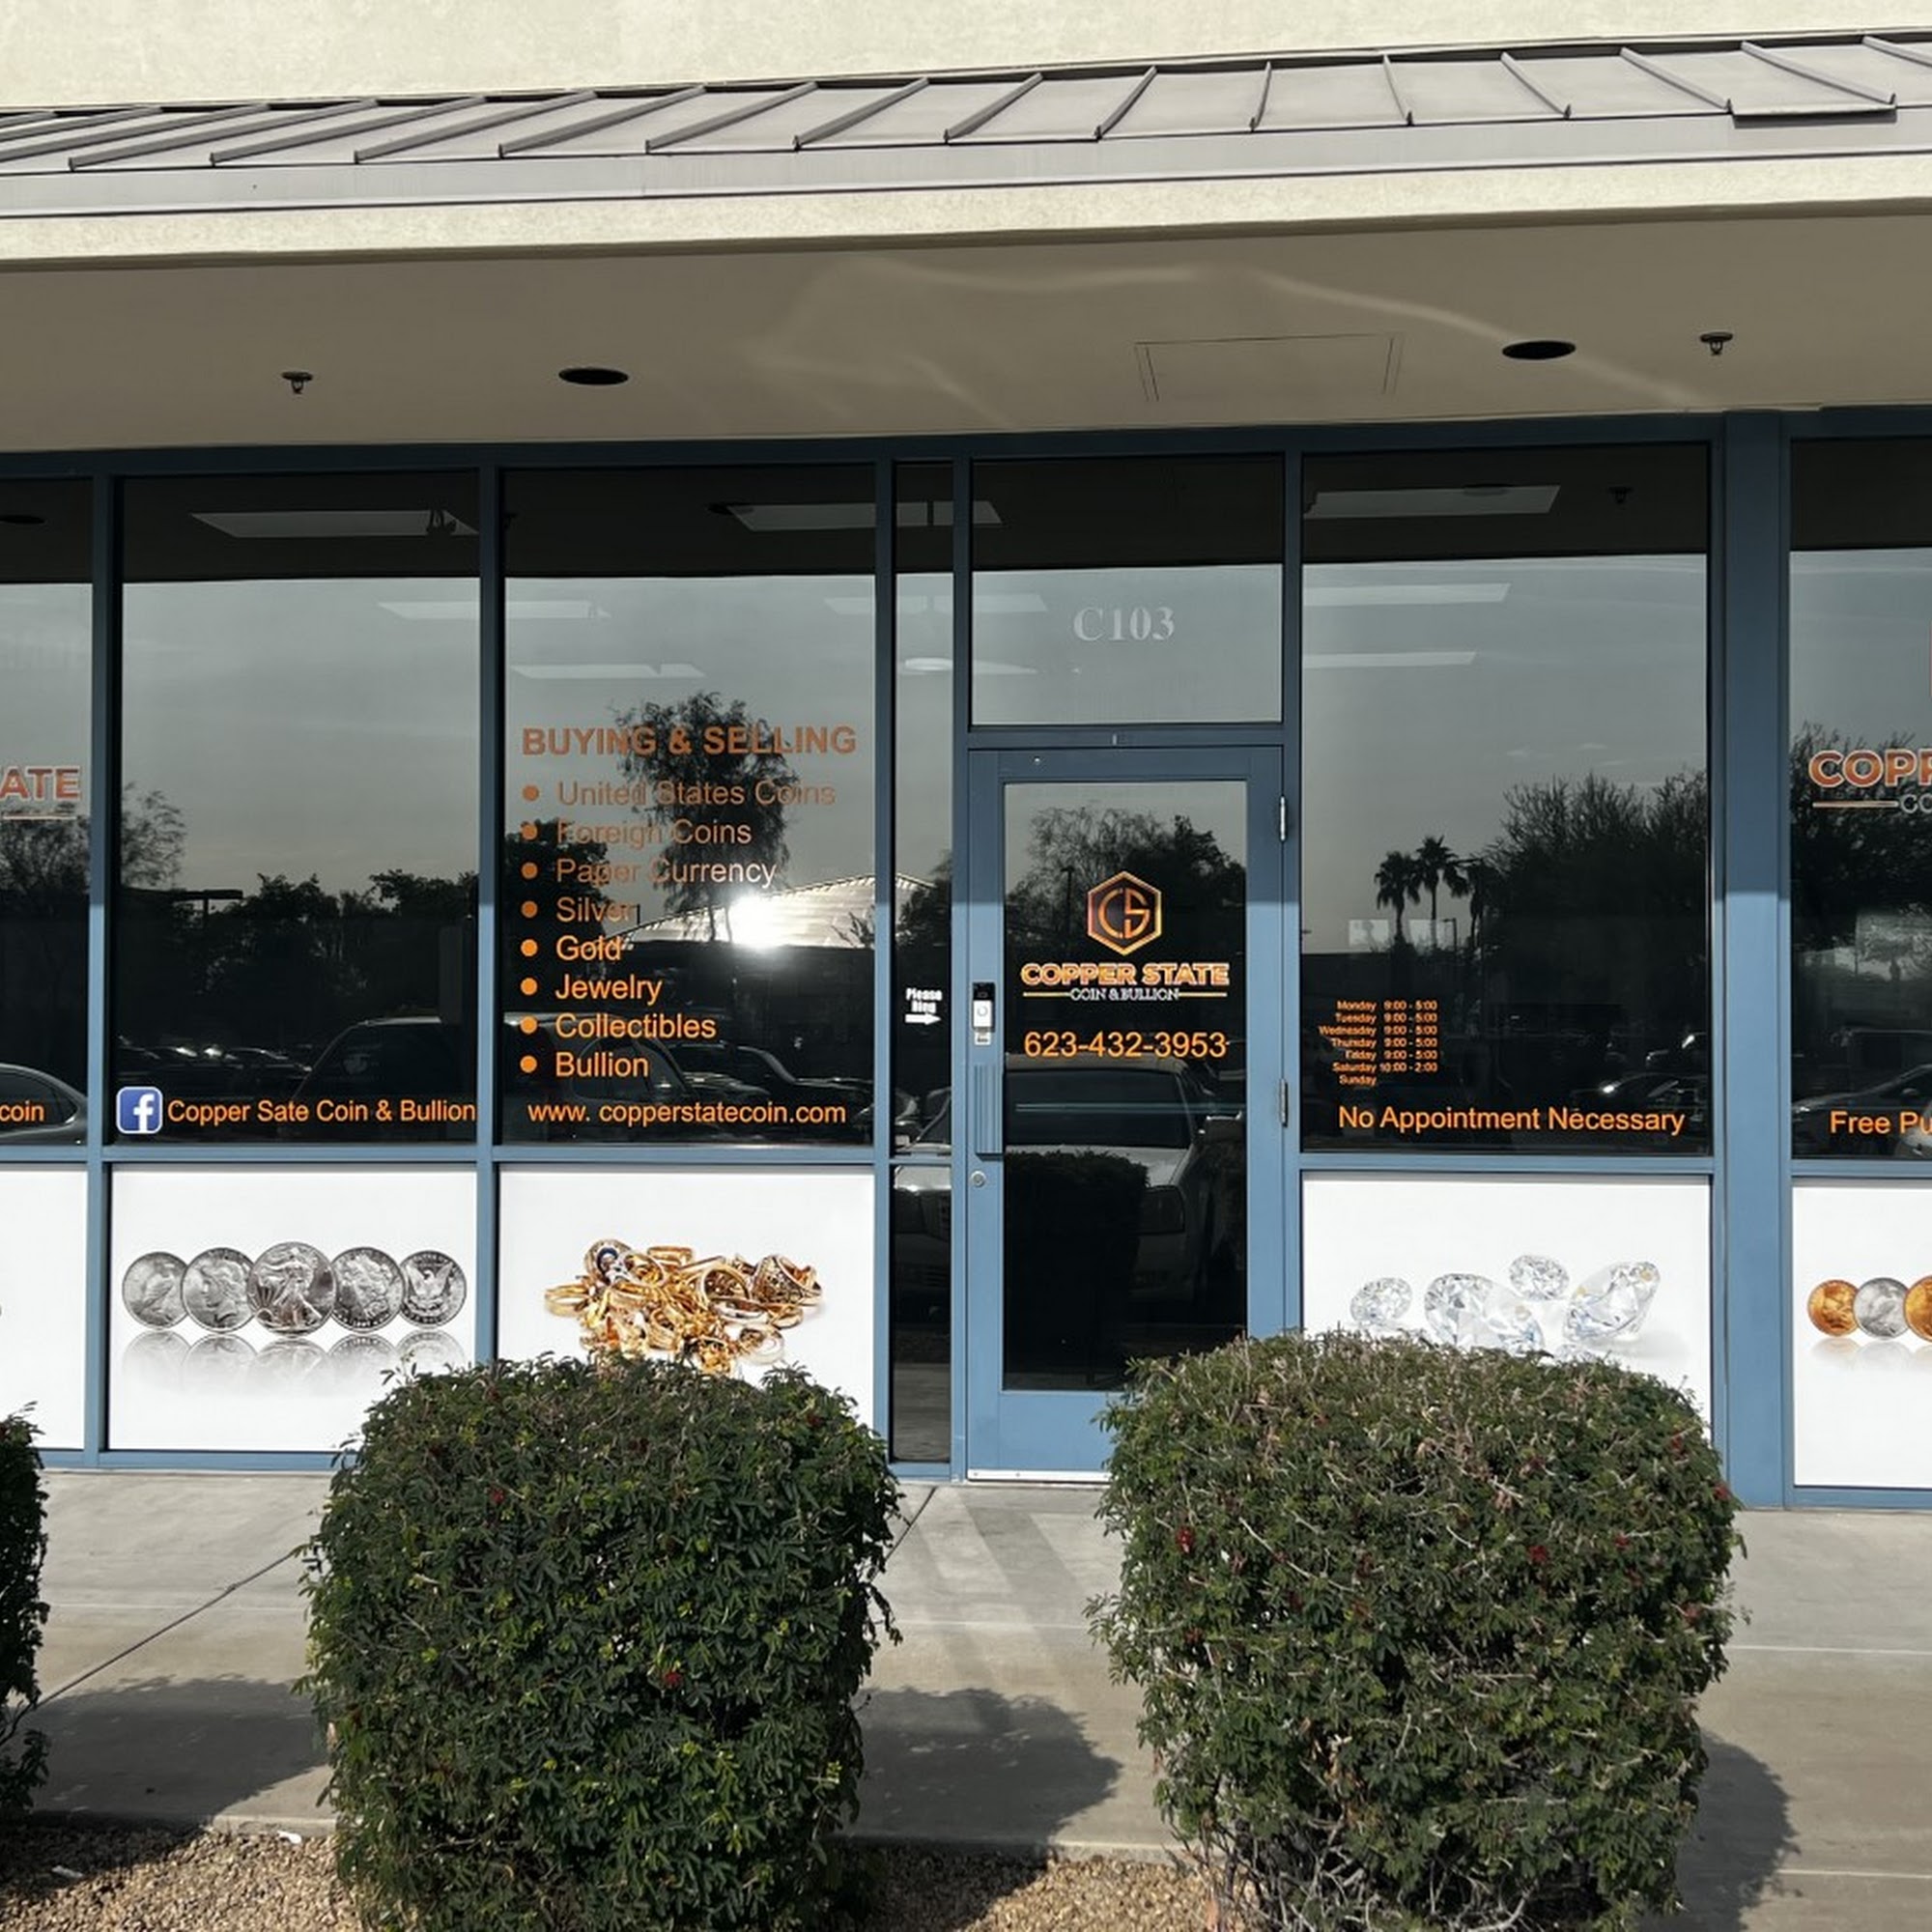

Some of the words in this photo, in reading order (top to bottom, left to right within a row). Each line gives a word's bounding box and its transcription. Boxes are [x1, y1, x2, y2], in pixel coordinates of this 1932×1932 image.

[1073, 607, 1176, 641] C103
[523, 726, 656, 755] BUYING
[668, 726, 692, 754] &
[703, 726, 856, 754] SELLING
[556, 781, 647, 806] United
[657, 781, 745, 806] States
[754, 781, 836, 806] Coins
[557, 819, 661, 849] Foreign
[671, 819, 752, 844] Coins
[556, 859, 639, 888] Paper
[650, 858, 776, 888] Currency
[556, 897, 633, 923] Silver
[556, 935, 621, 961] Gold
[1021, 963, 1136, 985] COPPER
[1143, 963, 1230, 985] STATE
[555, 974, 662, 1004] Jewelry
[906, 987, 943, 1001] Please
[1070, 988, 1107, 1001] COIN
[1121, 988, 1179, 1001] BULLION
[555, 1012, 716, 1039] Collectibles
[1024, 1032, 1227, 1057] 623-432-3953
[555, 1051, 648, 1077] Bullion
[167, 1100, 251, 1128] Copper
[258, 1099, 309, 1122] Sate
[316, 1099, 368, 1122] Coin
[375, 1099, 392, 1122] &
[401, 1099, 475, 1122] Bullion
[528, 1104, 590, 1122] www.
[599, 1101, 846, 1126] copperstatecoin.com
[1339, 1106, 1375, 1129] No
[1380, 1106, 1541, 1133] Appointment
[1548, 1107, 1685, 1135] Necessary
[1831, 1111, 1890, 1134] Free
